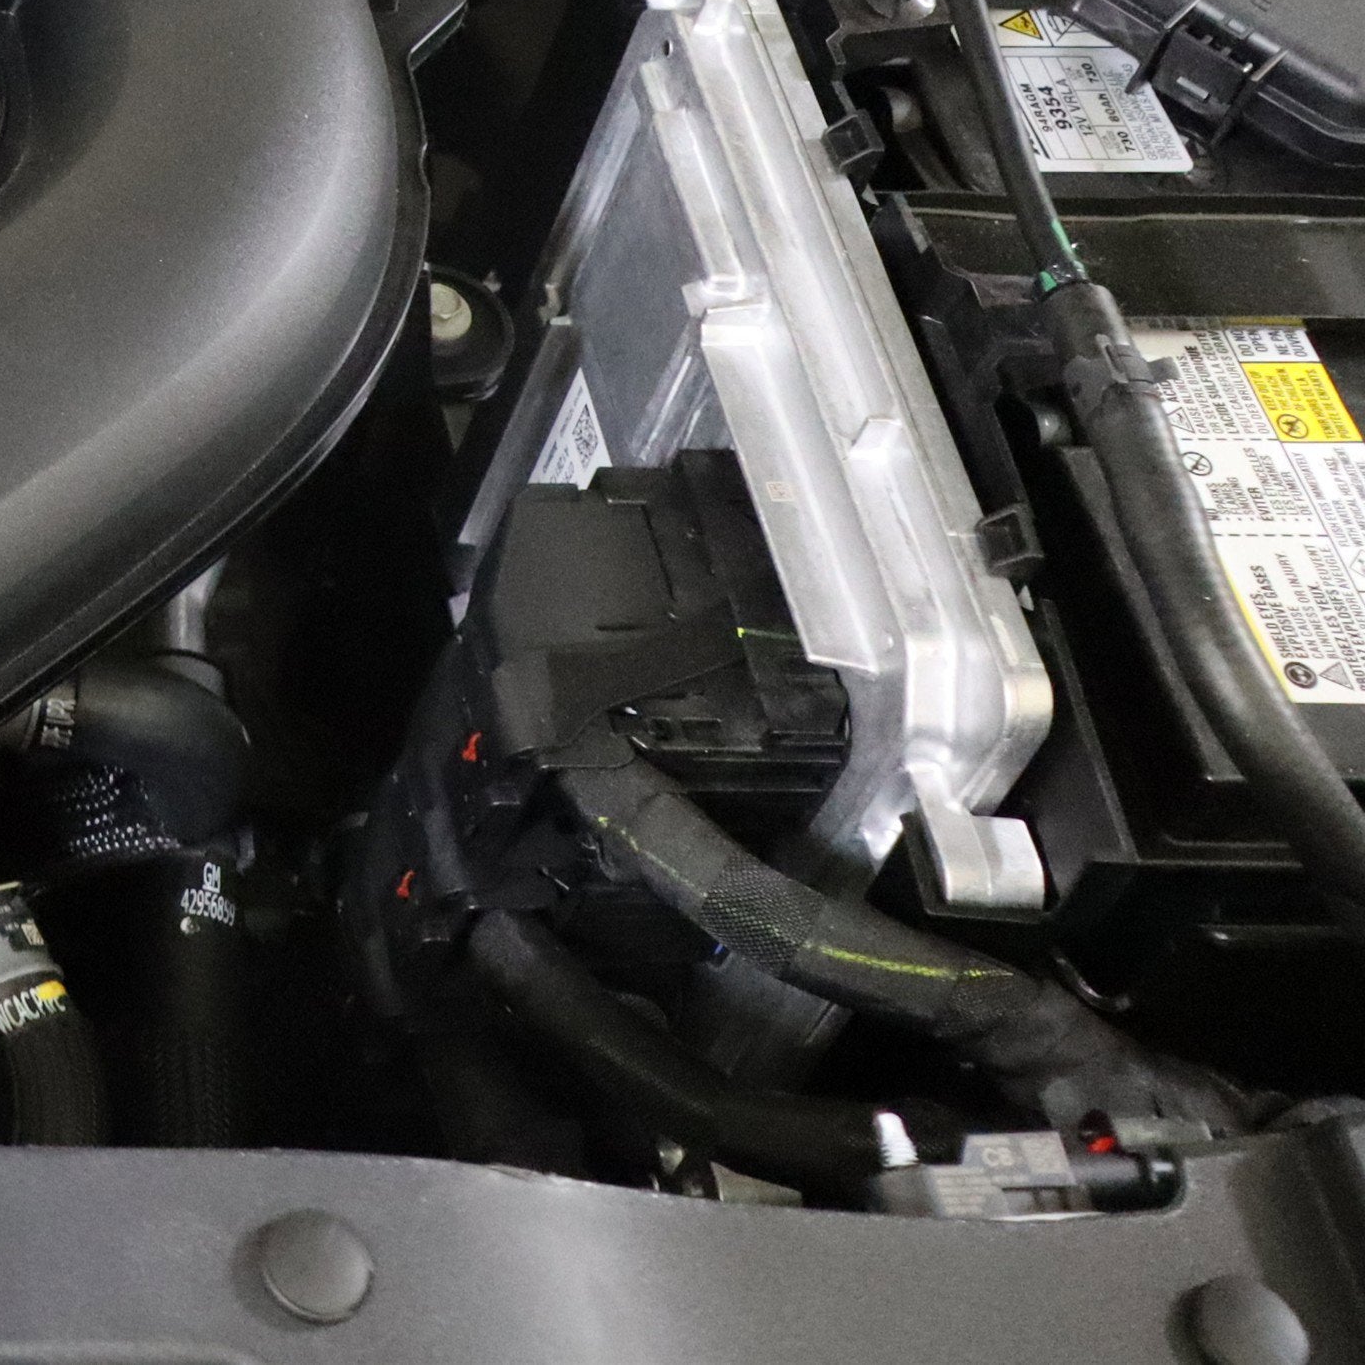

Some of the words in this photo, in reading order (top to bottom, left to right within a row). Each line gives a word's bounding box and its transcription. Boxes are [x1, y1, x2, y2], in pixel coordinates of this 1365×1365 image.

[1081, 63, 1099, 84] 730
[1056, 79, 1081, 112] VRLA
[1020, 84, 1053, 132] 94RAGM
[1037, 87, 1073, 130] 9354
[1099, 93, 1120, 122] 80Ah
[1073, 116, 1093, 136] 12V
[1117, 131, 1136, 152] 730
[1238, 344, 1254, 356] DO
[1275, 344, 1292, 355] NE
[1185, 346, 1221, 399] SULFURIQUE
[1212, 364, 1224, 373] LA
[1255, 381, 1269, 393] OUT
[1266, 376, 1285, 397] REACH
[1296, 377, 1308, 386] LA
[1301, 388, 1313, 396] DE
[1218, 376, 1243, 409] CAUSER
[1263, 395, 1277, 410] KEEP
[1192, 388, 1219, 419] SEVERE
[1245, 404, 1263, 419] DES
[1279, 400, 1292, 411] THE
[1295, 403, 1306, 411] OF
[1307, 399, 1325, 417] HORS
[1187, 407, 1210, 433] CAUSE
[1212, 402, 1239, 434] L'ACIDE
[1212, 422, 1224, 433] OR
[1236, 412, 1255, 433] PEUT
[1255, 422, 1270, 433] OU
[1319, 419, 1336, 439] TENIR
[1259, 455, 1287, 497] FLAMMES
[1281, 472, 1304, 501] FUMER
[1292, 452, 1326, 500] IMMEDIATELY
[1227, 477, 1255, 515] SMOKING
[1334, 478, 1352, 496] HELP
[1206, 483, 1228, 514] SPARKS
[1218, 483, 1241, 515] FLAMES
[1270, 500, 1286, 515] LES
[1282, 500, 1299, 515] LES
[1299, 506, 1312, 515] DE
[1320, 503, 1337, 520] EYES
[1330, 523, 1349, 547] FLUSH
[1345, 527, 1363, 547] WITH
[1304, 544, 1334, 586] PEUVENT
[1250, 565, 1277, 598] GASES
[1296, 591, 1308, 602] OR
[1287, 606, 1315, 636] CAUSE
[1323, 616, 1342, 633] LES
[1326, 590, 1365, 645] EXPLOSIFS
[1265, 623, 1294, 658] SHIELD
[1269, 602, 1308, 658] EXPLOSIVE
[1303, 606, 1339, 658] BLINDNESS
[1304, 640, 1323, 658] CAN
[203, 862, 221, 891] GM
